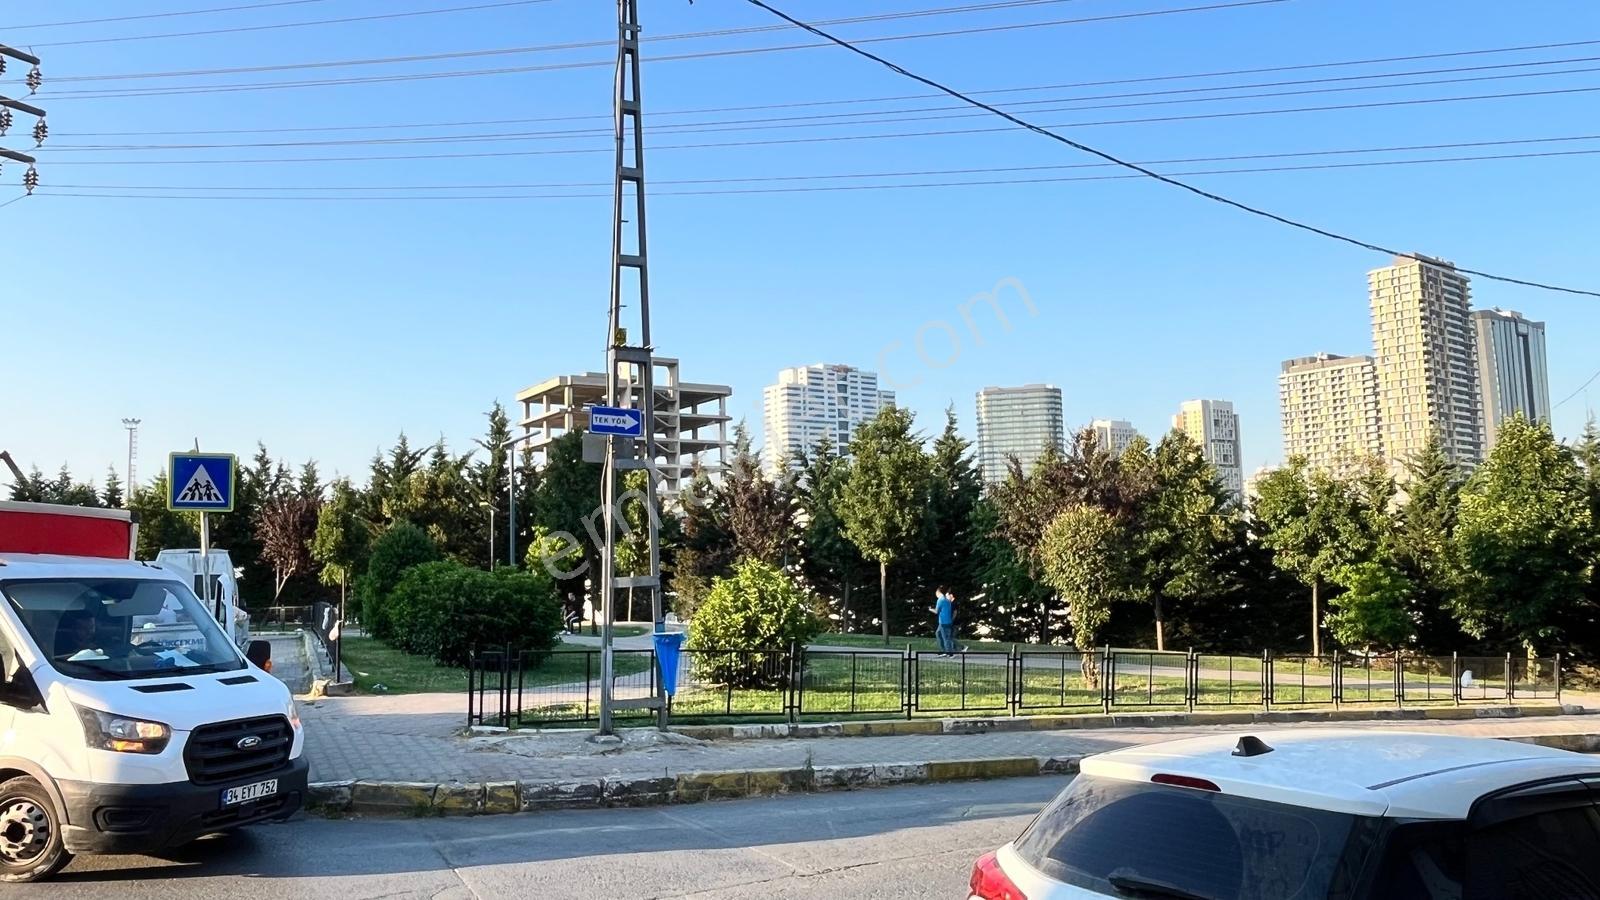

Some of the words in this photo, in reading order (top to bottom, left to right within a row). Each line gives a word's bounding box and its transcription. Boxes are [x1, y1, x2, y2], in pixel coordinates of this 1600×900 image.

[611, 416, 627, 424] YÖN
[228, 789, 238, 802] 34
[241, 785, 257, 799] EYT
[260, 781, 275, 795] 752
